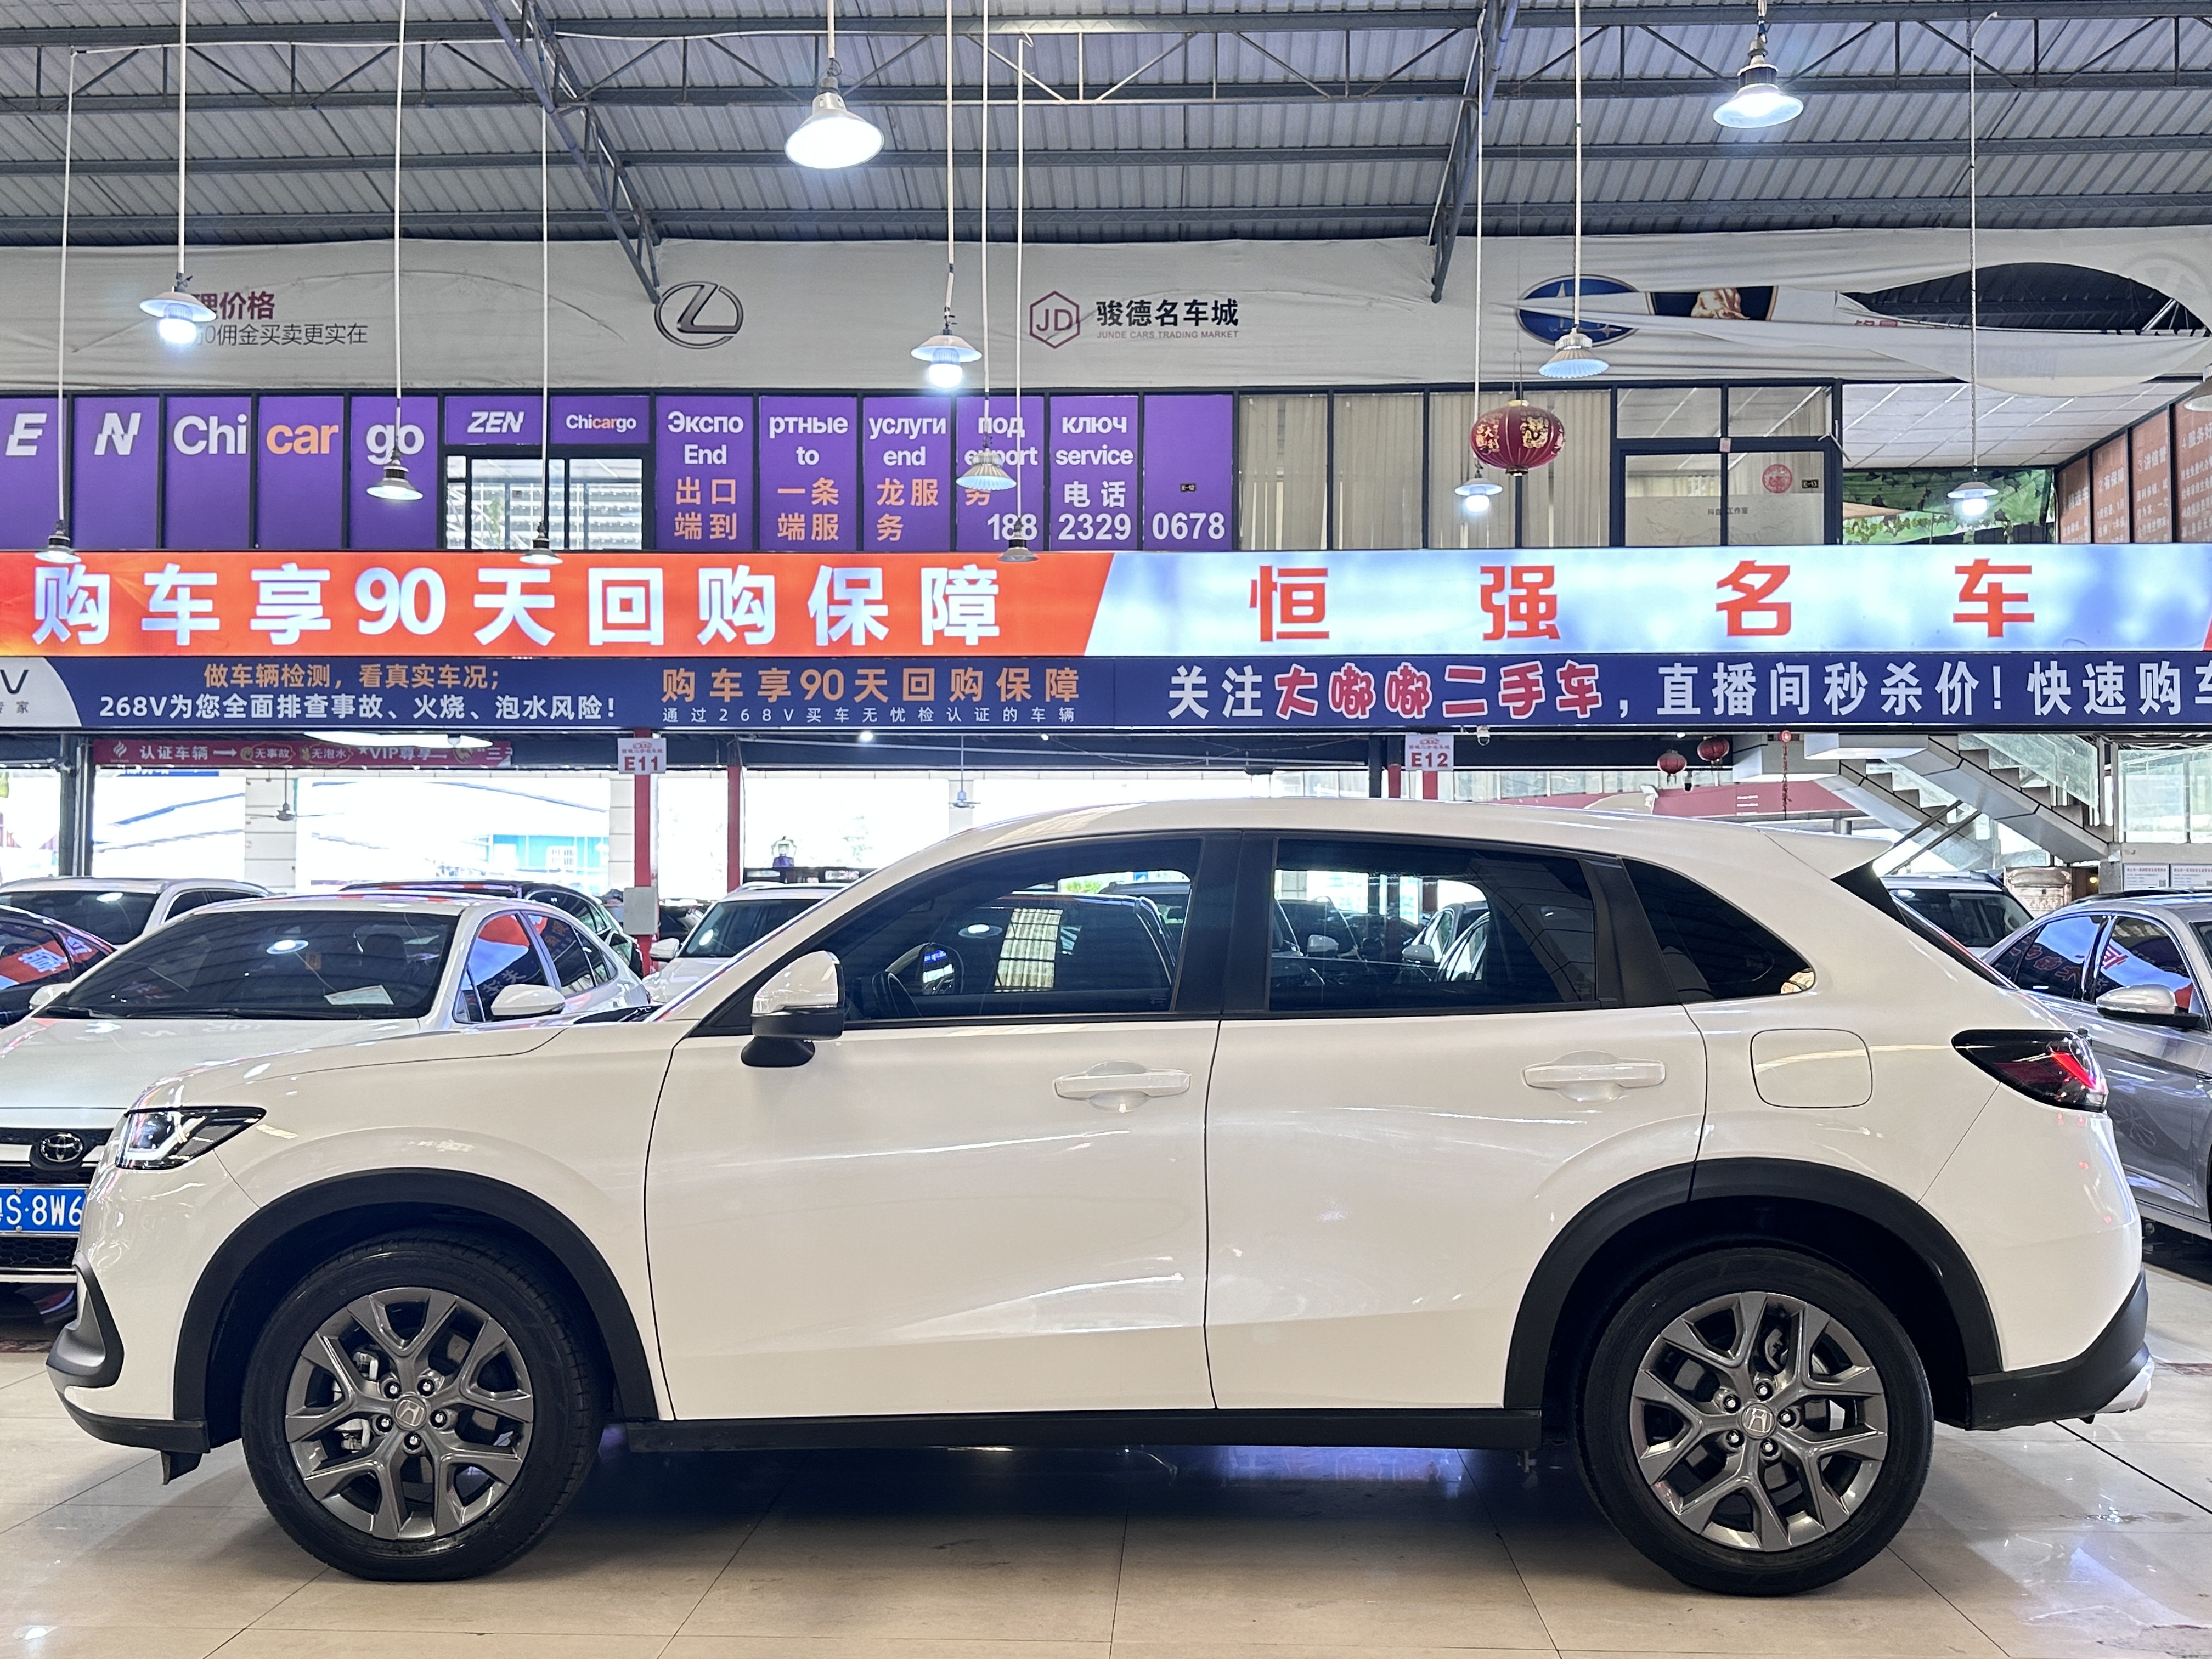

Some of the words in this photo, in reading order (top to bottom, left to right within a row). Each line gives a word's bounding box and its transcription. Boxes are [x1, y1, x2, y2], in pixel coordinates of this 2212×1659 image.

[1036, 308, 1073, 331] JD
[1096, 299, 1239, 326] 骏德名车城
[1097, 330, 1126, 338] JUNDE
[1130, 330, 1154, 338] CARS
[1158, 330, 1198, 338] TRADING
[1201, 330, 1238, 338] MARKET
[467, 411, 524, 433] ZEN
[566, 414, 636, 432] Chicargo
[667, 411, 743, 433] Экспо
[769, 415, 848, 439] ртные
[869, 416, 946, 439] услуги
[978, 417, 1025, 438] под
[1062, 417, 1127, 434] ключ
[173, 414, 247, 455] Chi
[267, 424, 339, 455] car
[365, 424, 425, 466] go
[684, 444, 727, 465] End
[797, 447, 819, 466] to
[884, 447, 926, 466] end
[964, 447, 1038, 466] eort
[1056, 446, 1133, 465] service
[676, 477, 736, 505] 出口
[778, 478, 839, 505] 一条
[877, 479, 939, 506] 龙服
[1064, 481, 1126, 508] 电话
[674, 512, 737, 540] 端到
[777, 514, 839, 541] 端服
[877, 514, 904, 542] 务
[988, 513, 1037, 541] 188
[1058, 513, 1132, 541] 2329
[1153, 512, 1226, 540] 0678
[32, 563, 1000, 645] 购车享90天回购保障
[1250, 558, 2035, 641] 恒强名车
[661, 667, 1080, 703] 购车享90天回购保障
[139, 745, 208, 761] 认证车辆
[255, 748, 290, 759] 无事故
[624, 756, 658, 771] E11
[1411, 752, 1448, 767] E12
[0, 1194, 82, 1227] S·8W6
